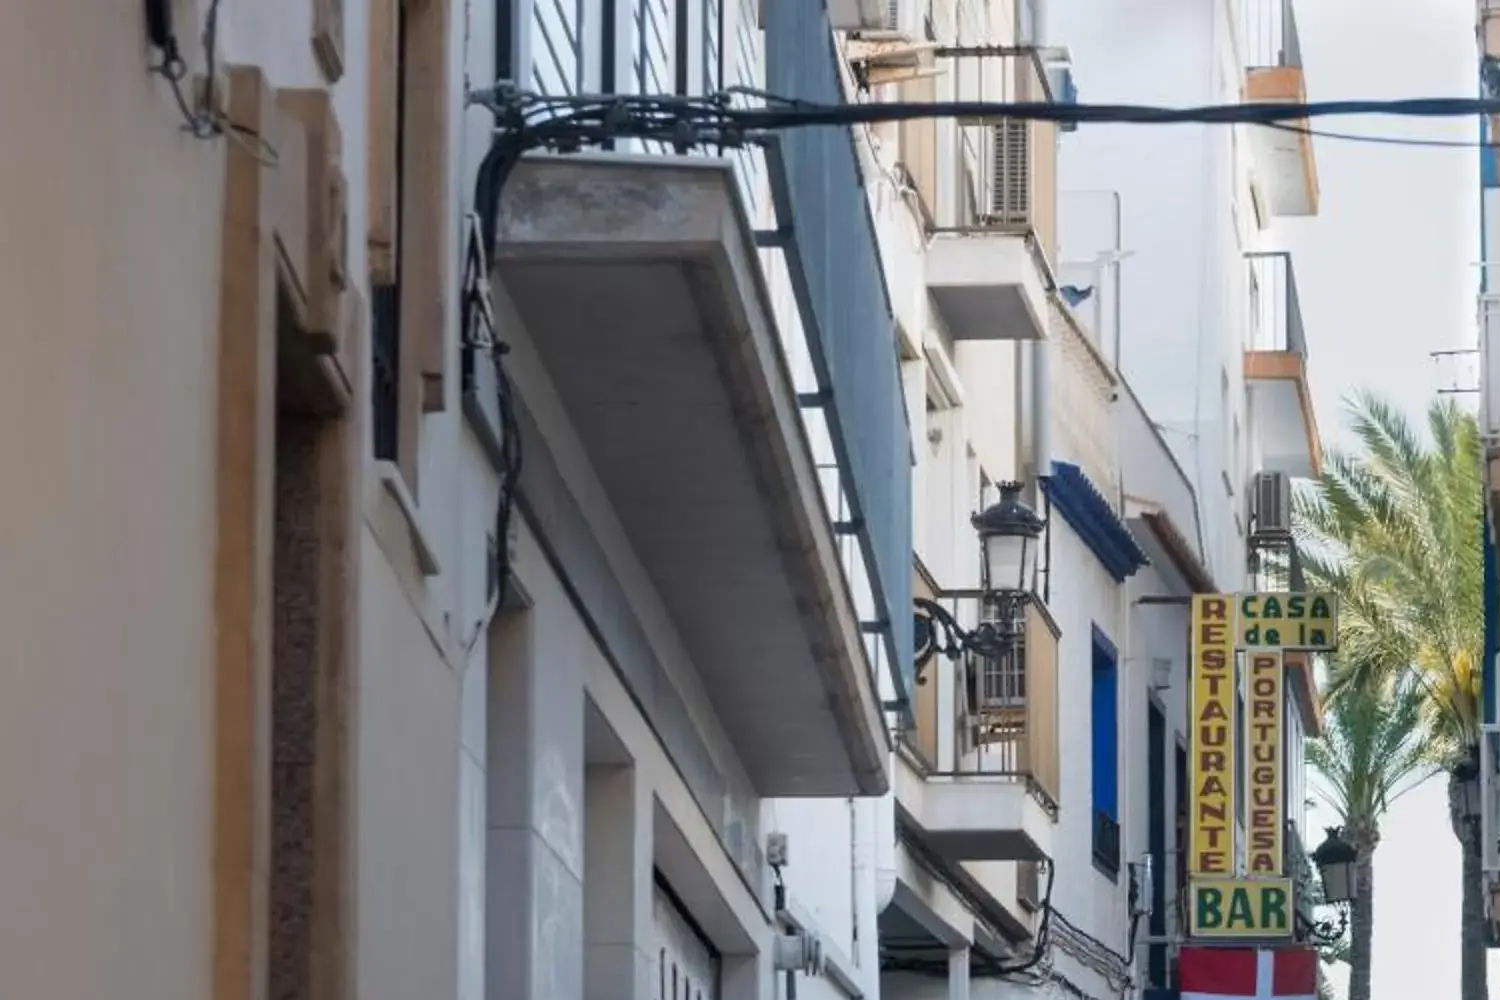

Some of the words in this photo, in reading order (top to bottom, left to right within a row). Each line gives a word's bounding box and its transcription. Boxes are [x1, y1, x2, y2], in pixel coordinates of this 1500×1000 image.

[1240, 595, 1331, 620] CASA
[1244, 623, 1281, 646] de
[1299, 623, 1325, 646] la
[1200, 598, 1227, 874] RESTAURANTE
[1252, 656, 1276, 873] PORTUGUESA
[1196, 886, 1287, 930] BAR
